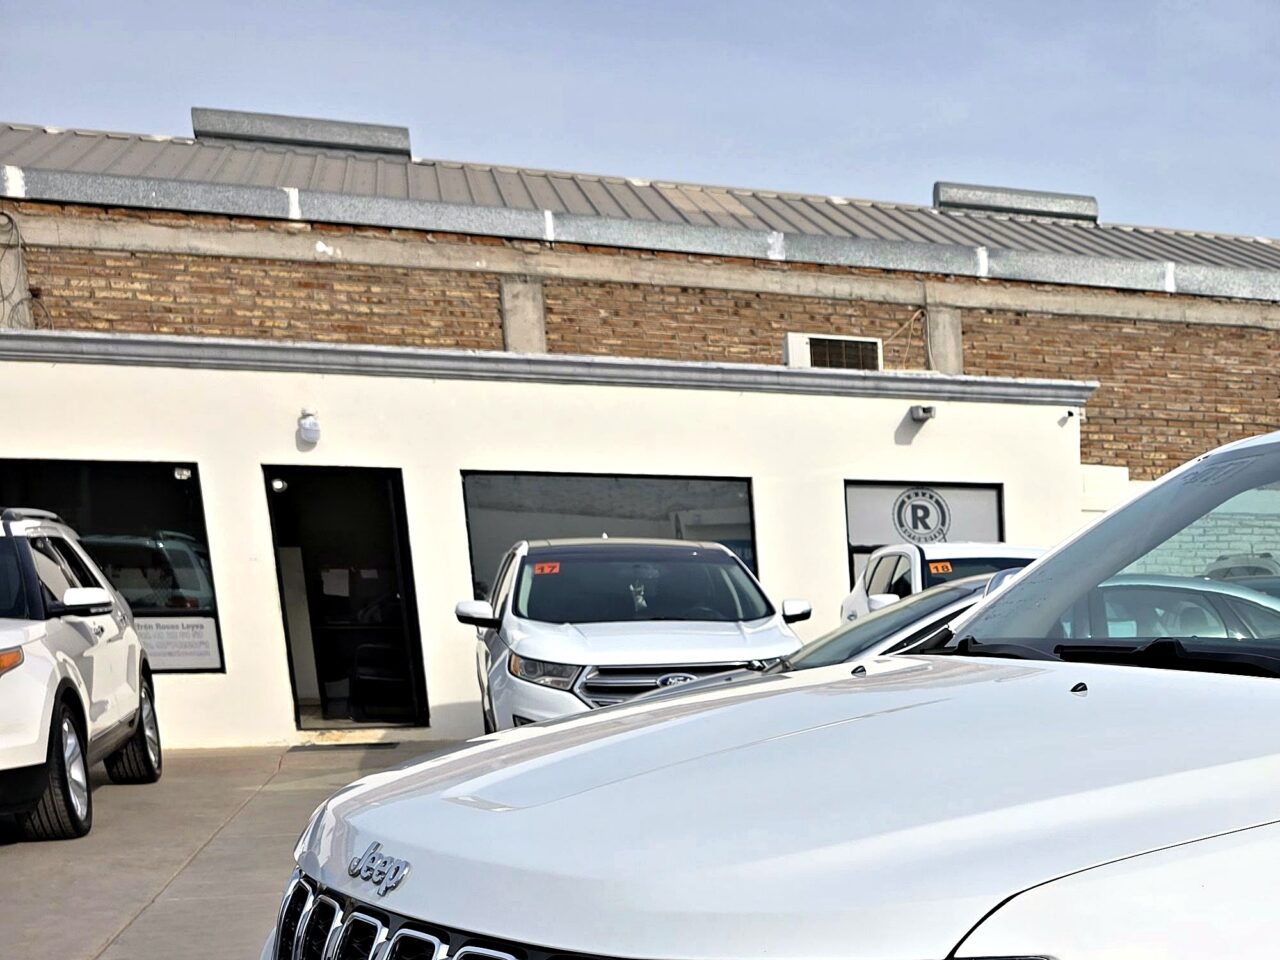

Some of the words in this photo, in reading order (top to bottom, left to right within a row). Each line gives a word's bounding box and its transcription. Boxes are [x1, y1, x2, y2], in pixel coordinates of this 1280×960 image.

[911, 504, 931, 530] R
[536, 564, 557, 573] 17
[932, 564, 950, 573] 18
[348, 841, 411, 897] Jeep
